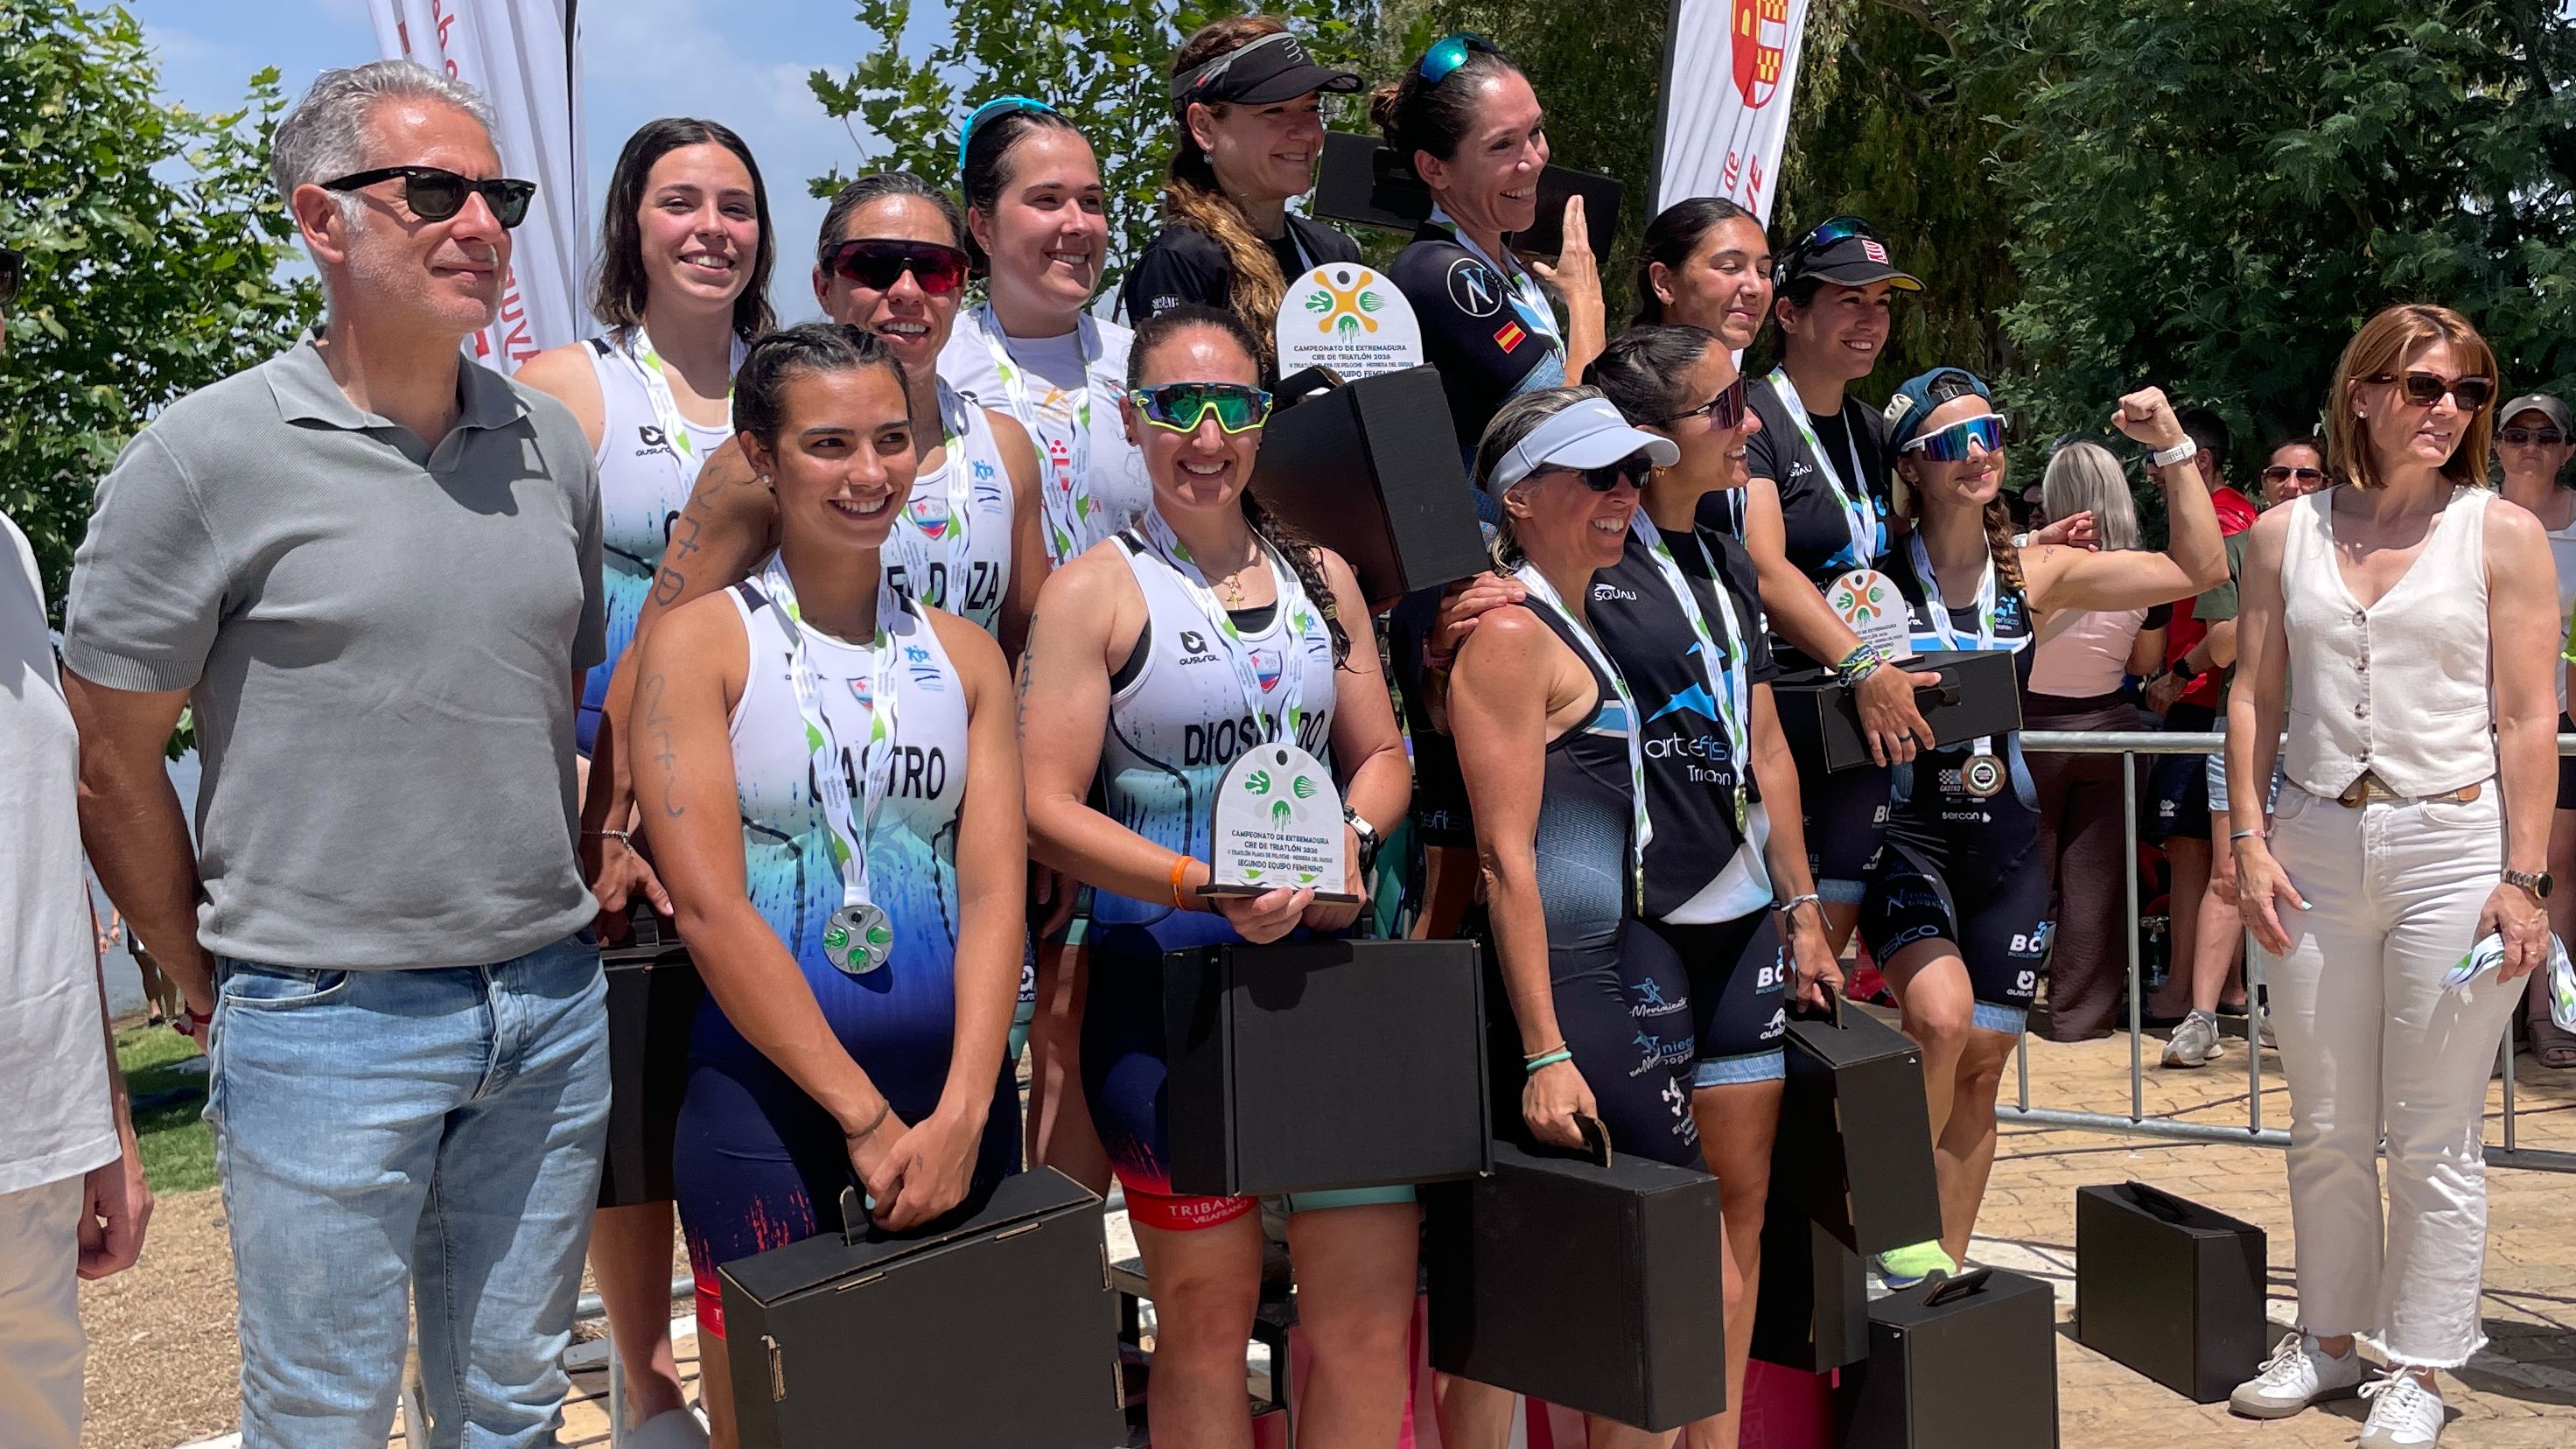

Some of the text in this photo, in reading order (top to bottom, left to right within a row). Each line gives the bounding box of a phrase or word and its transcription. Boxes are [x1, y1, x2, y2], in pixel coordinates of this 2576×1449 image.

[1231, 830, 1275, 840] CAMPEONATO
[1285, 835, 1329, 844] EXTREMADURA
[1238, 858, 1324, 872] SEGUNDO EQUIPO FEMENINO
